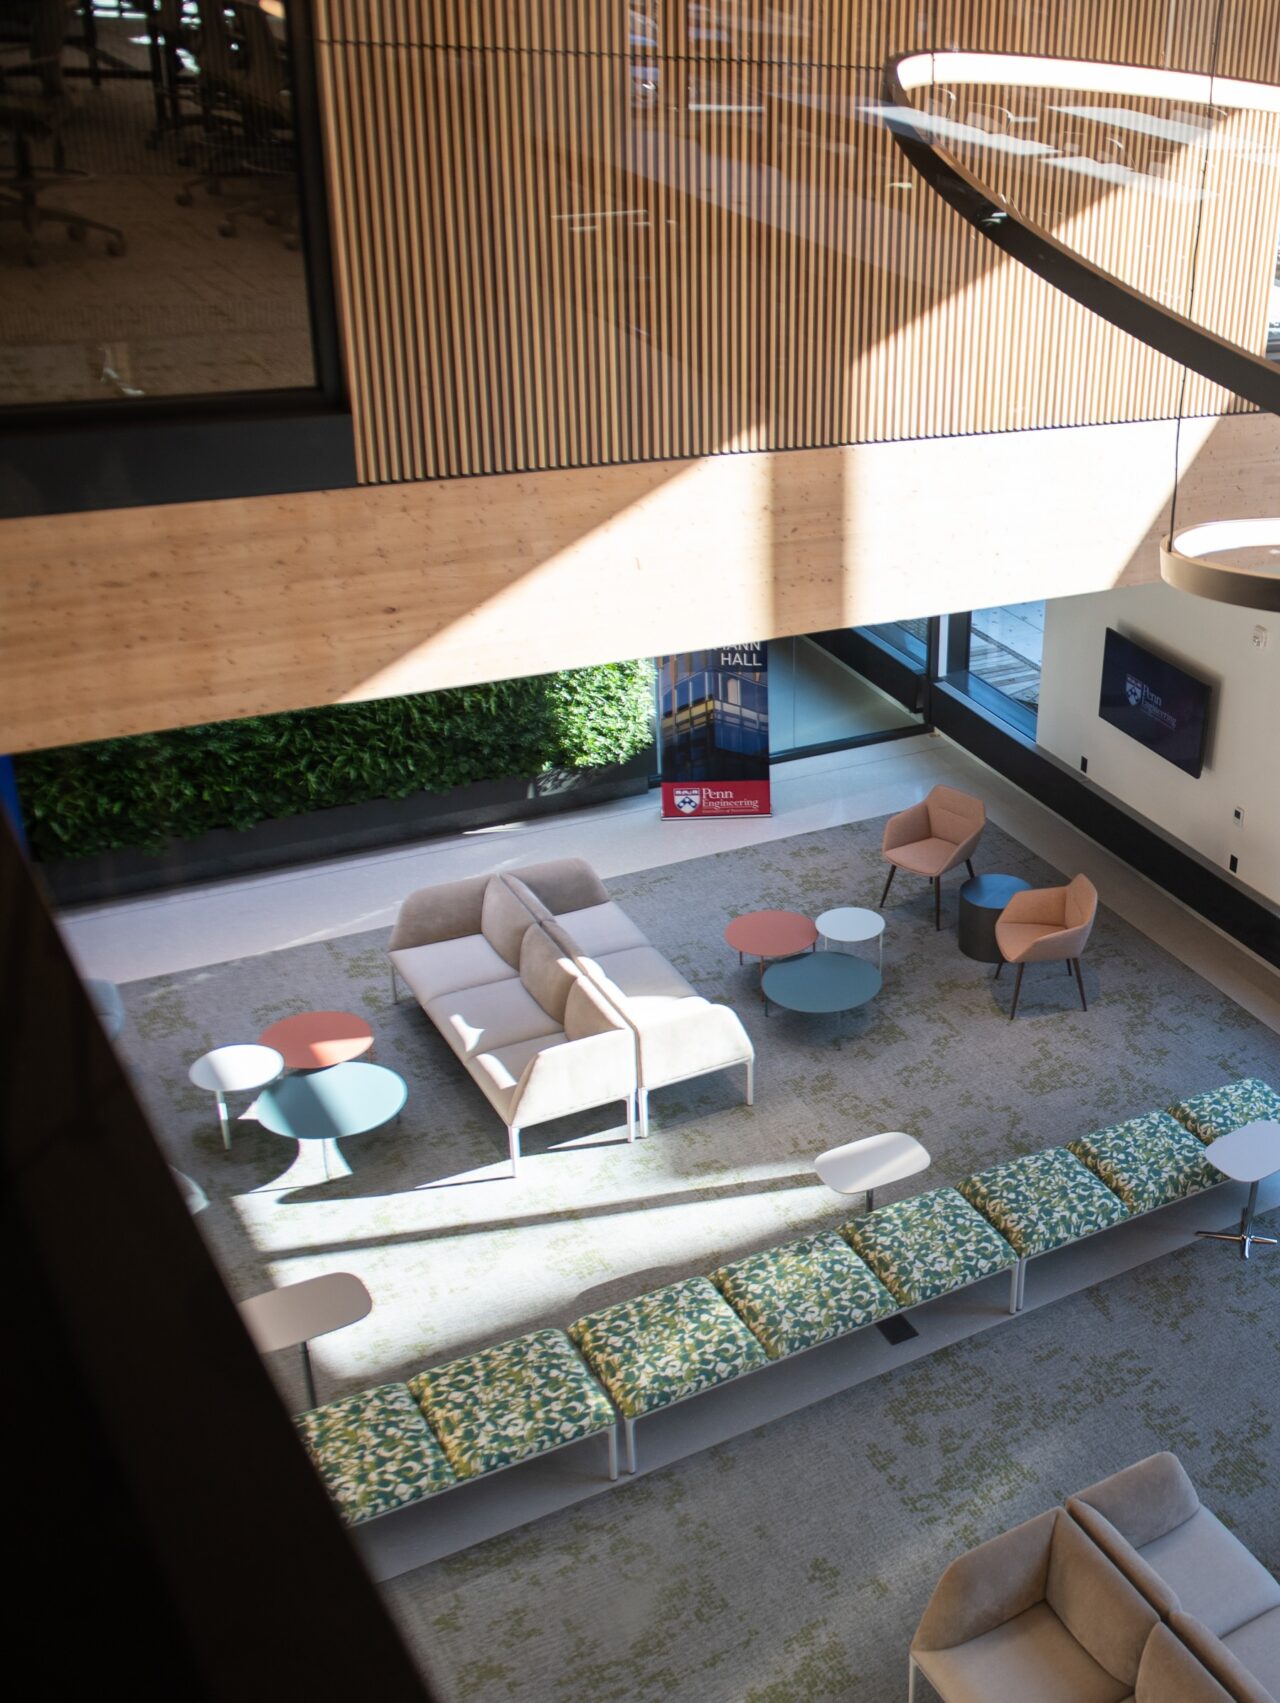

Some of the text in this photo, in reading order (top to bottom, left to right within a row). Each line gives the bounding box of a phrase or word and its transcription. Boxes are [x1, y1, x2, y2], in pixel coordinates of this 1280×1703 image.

[721, 653, 762, 666] HALL
[702, 788, 733, 799] Penn
[702, 798, 759, 810] Engineering
